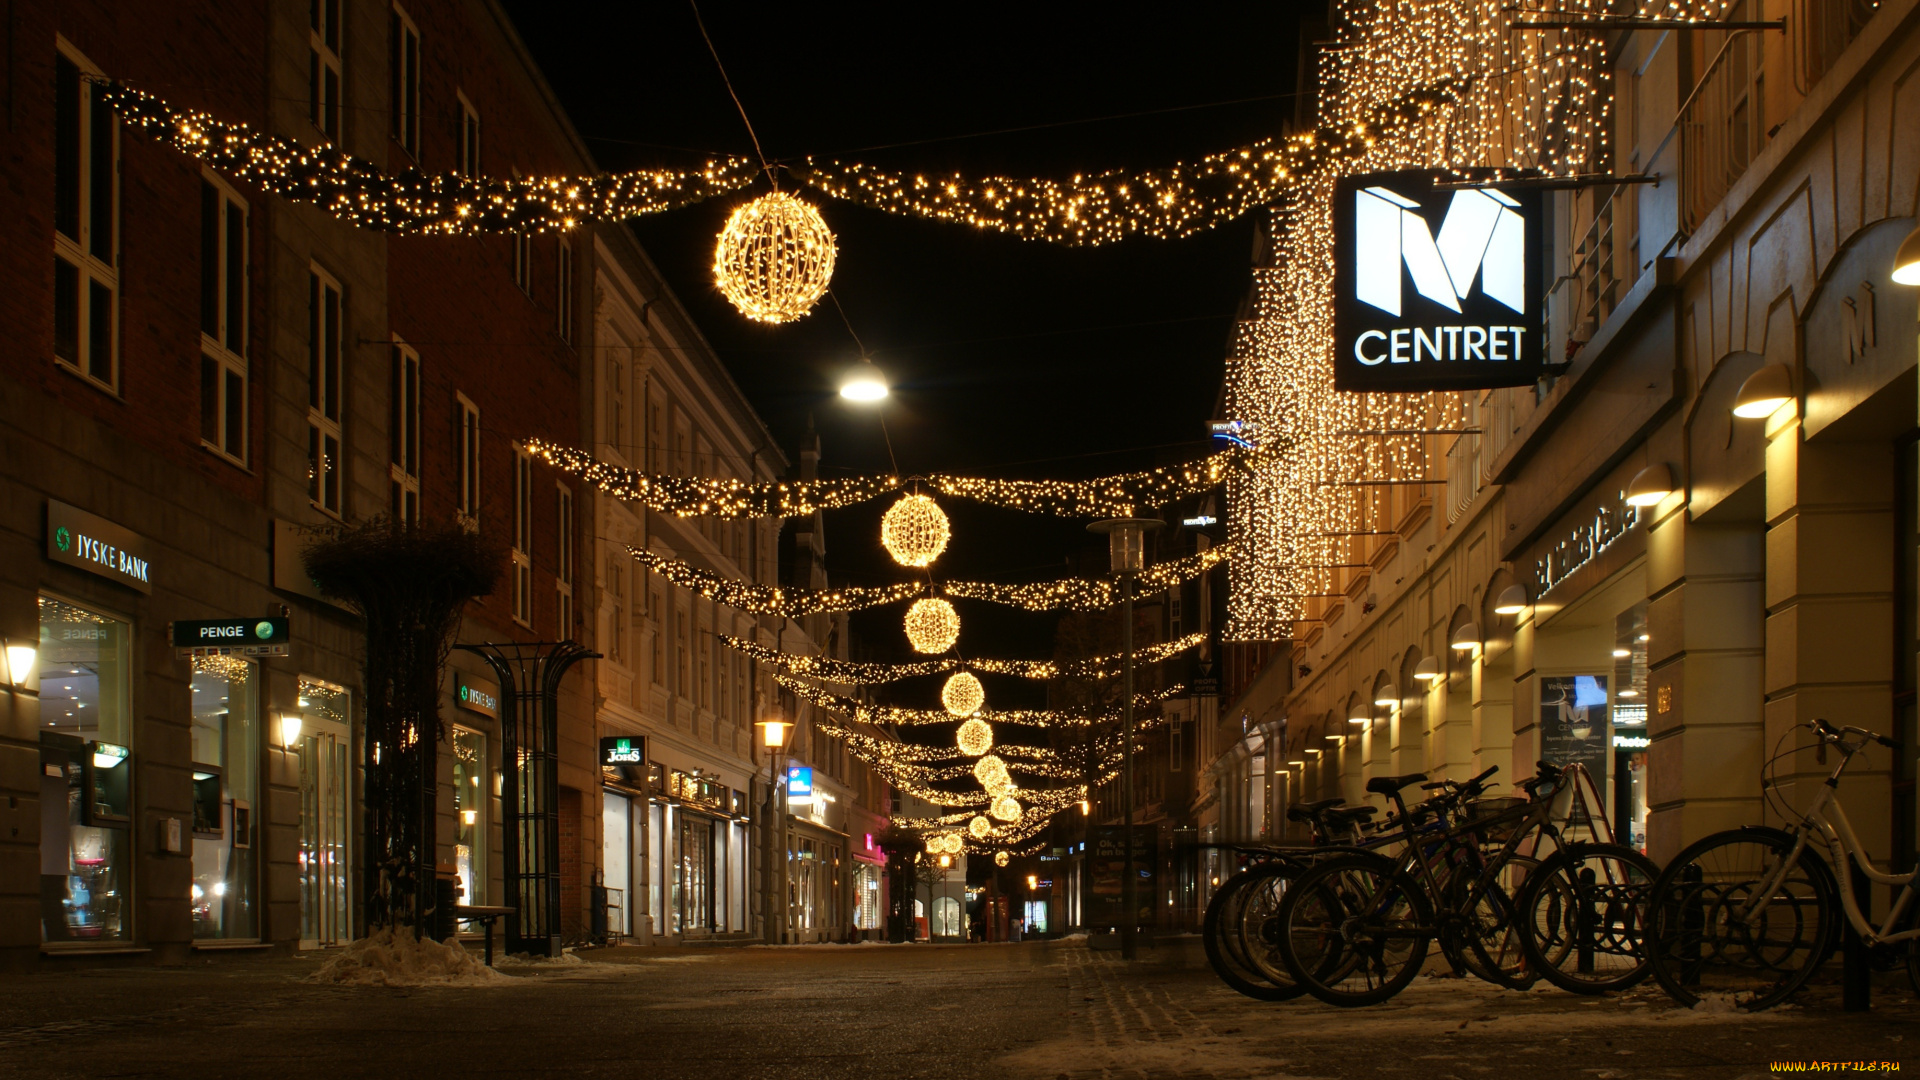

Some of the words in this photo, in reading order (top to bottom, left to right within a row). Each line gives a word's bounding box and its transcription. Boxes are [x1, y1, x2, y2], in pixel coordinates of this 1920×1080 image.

[1354, 326, 1526, 366] CENTRET
[77, 534, 116, 568] JYSKE
[119, 550, 149, 583] BANK
[200, 625, 244, 638] PENGE
